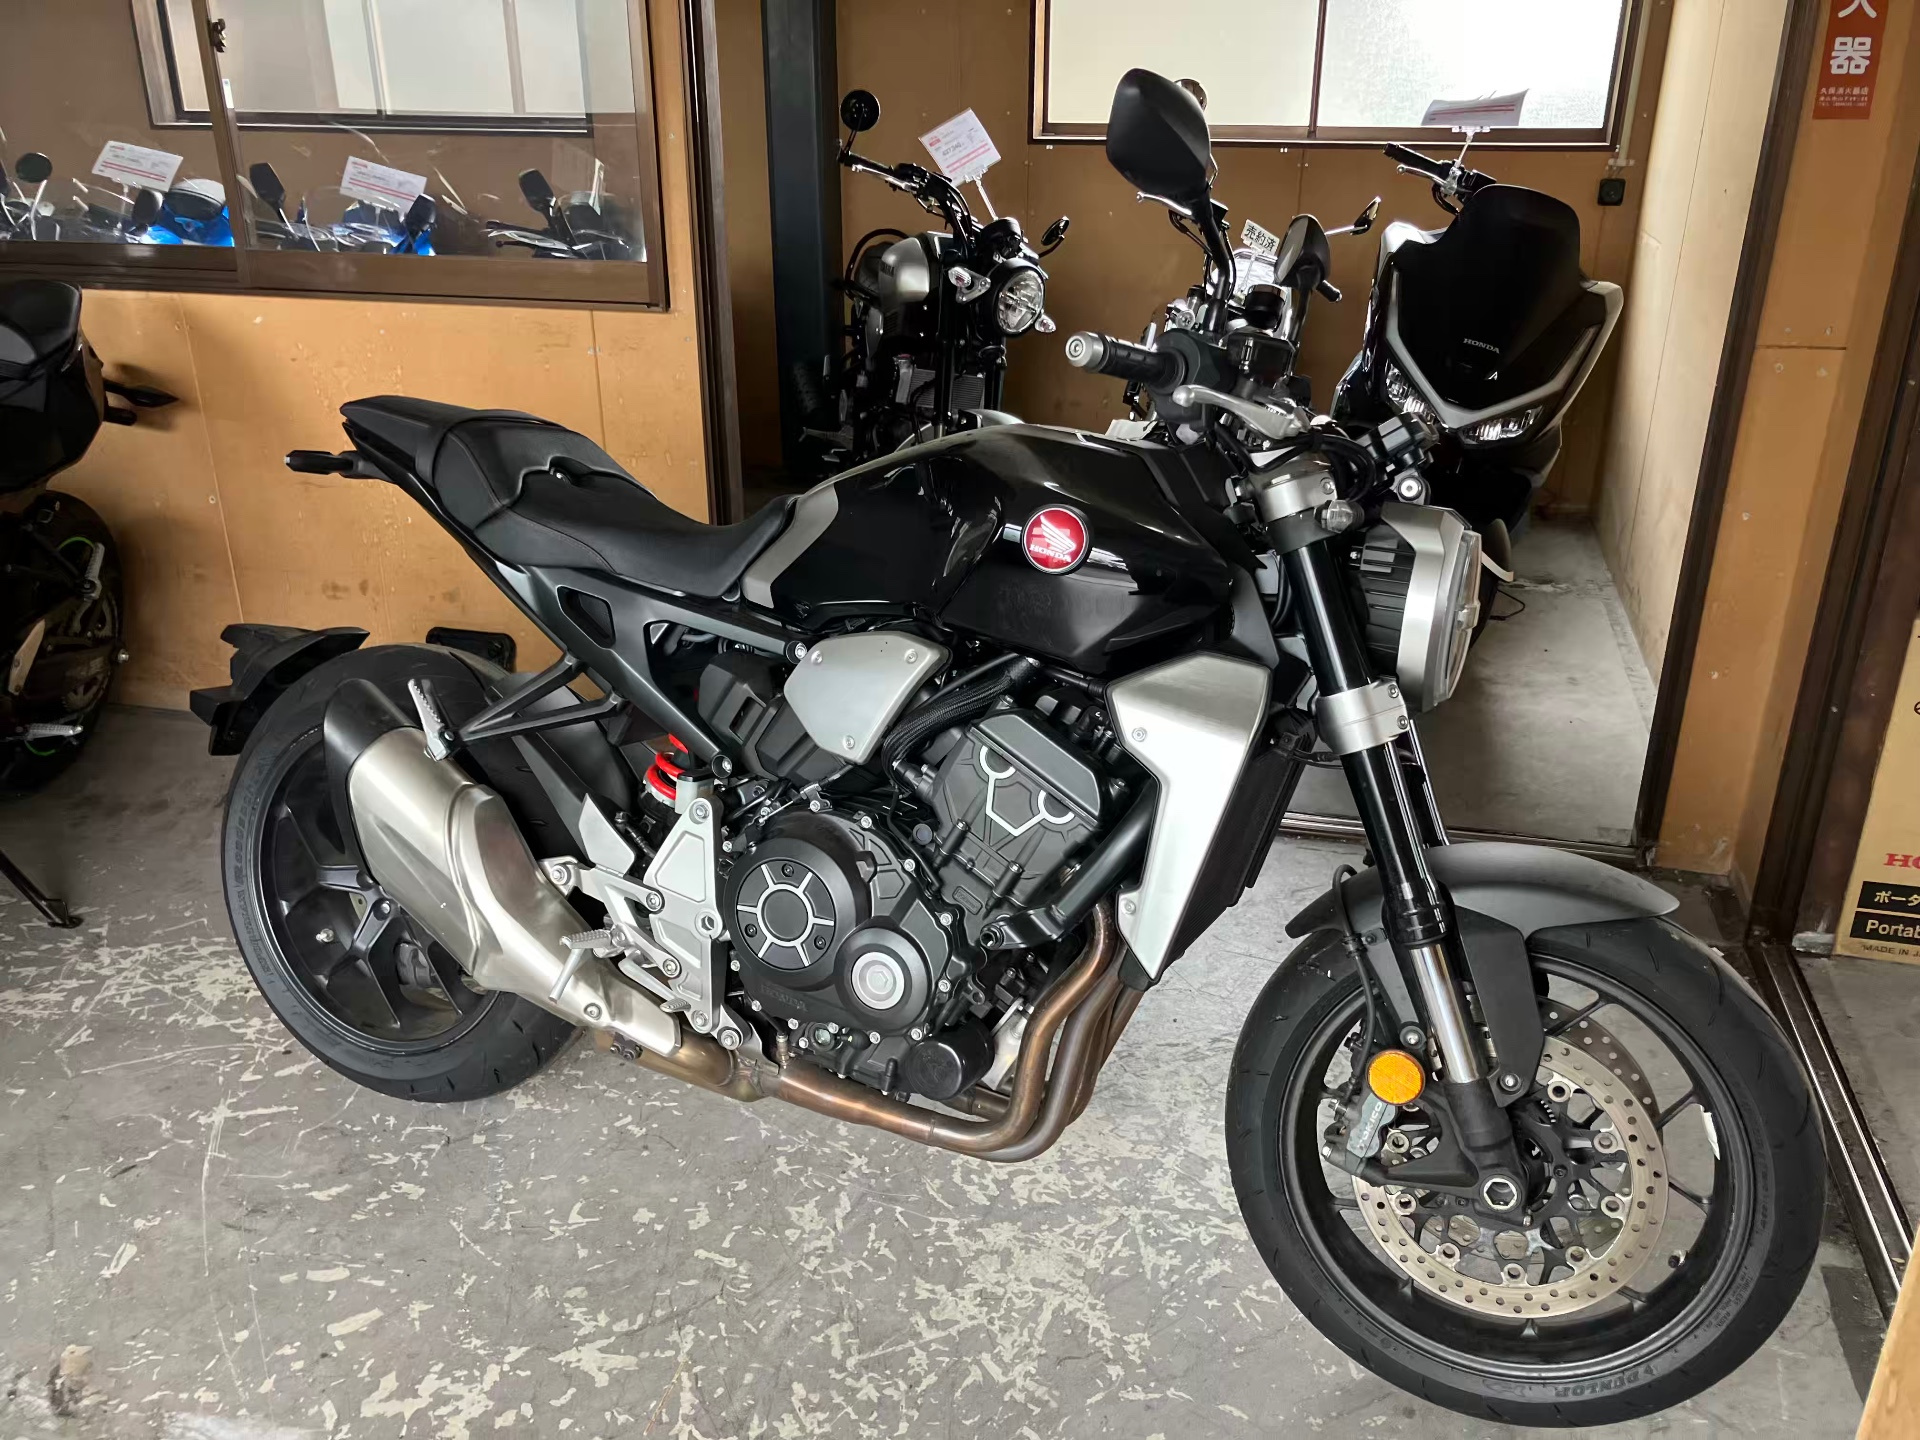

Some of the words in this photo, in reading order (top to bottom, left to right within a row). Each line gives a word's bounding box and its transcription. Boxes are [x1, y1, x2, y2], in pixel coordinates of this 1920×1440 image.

[1245, 225, 1276, 252] 売約済
[1463, 338, 1499, 354] HONDA
[1029, 543, 1072, 563] HONDA
[1874, 890, 1920, 907] ポータ
[1898, 948, 1909, 956] IN
[1554, 1370, 1640, 1398] DUNLOP
